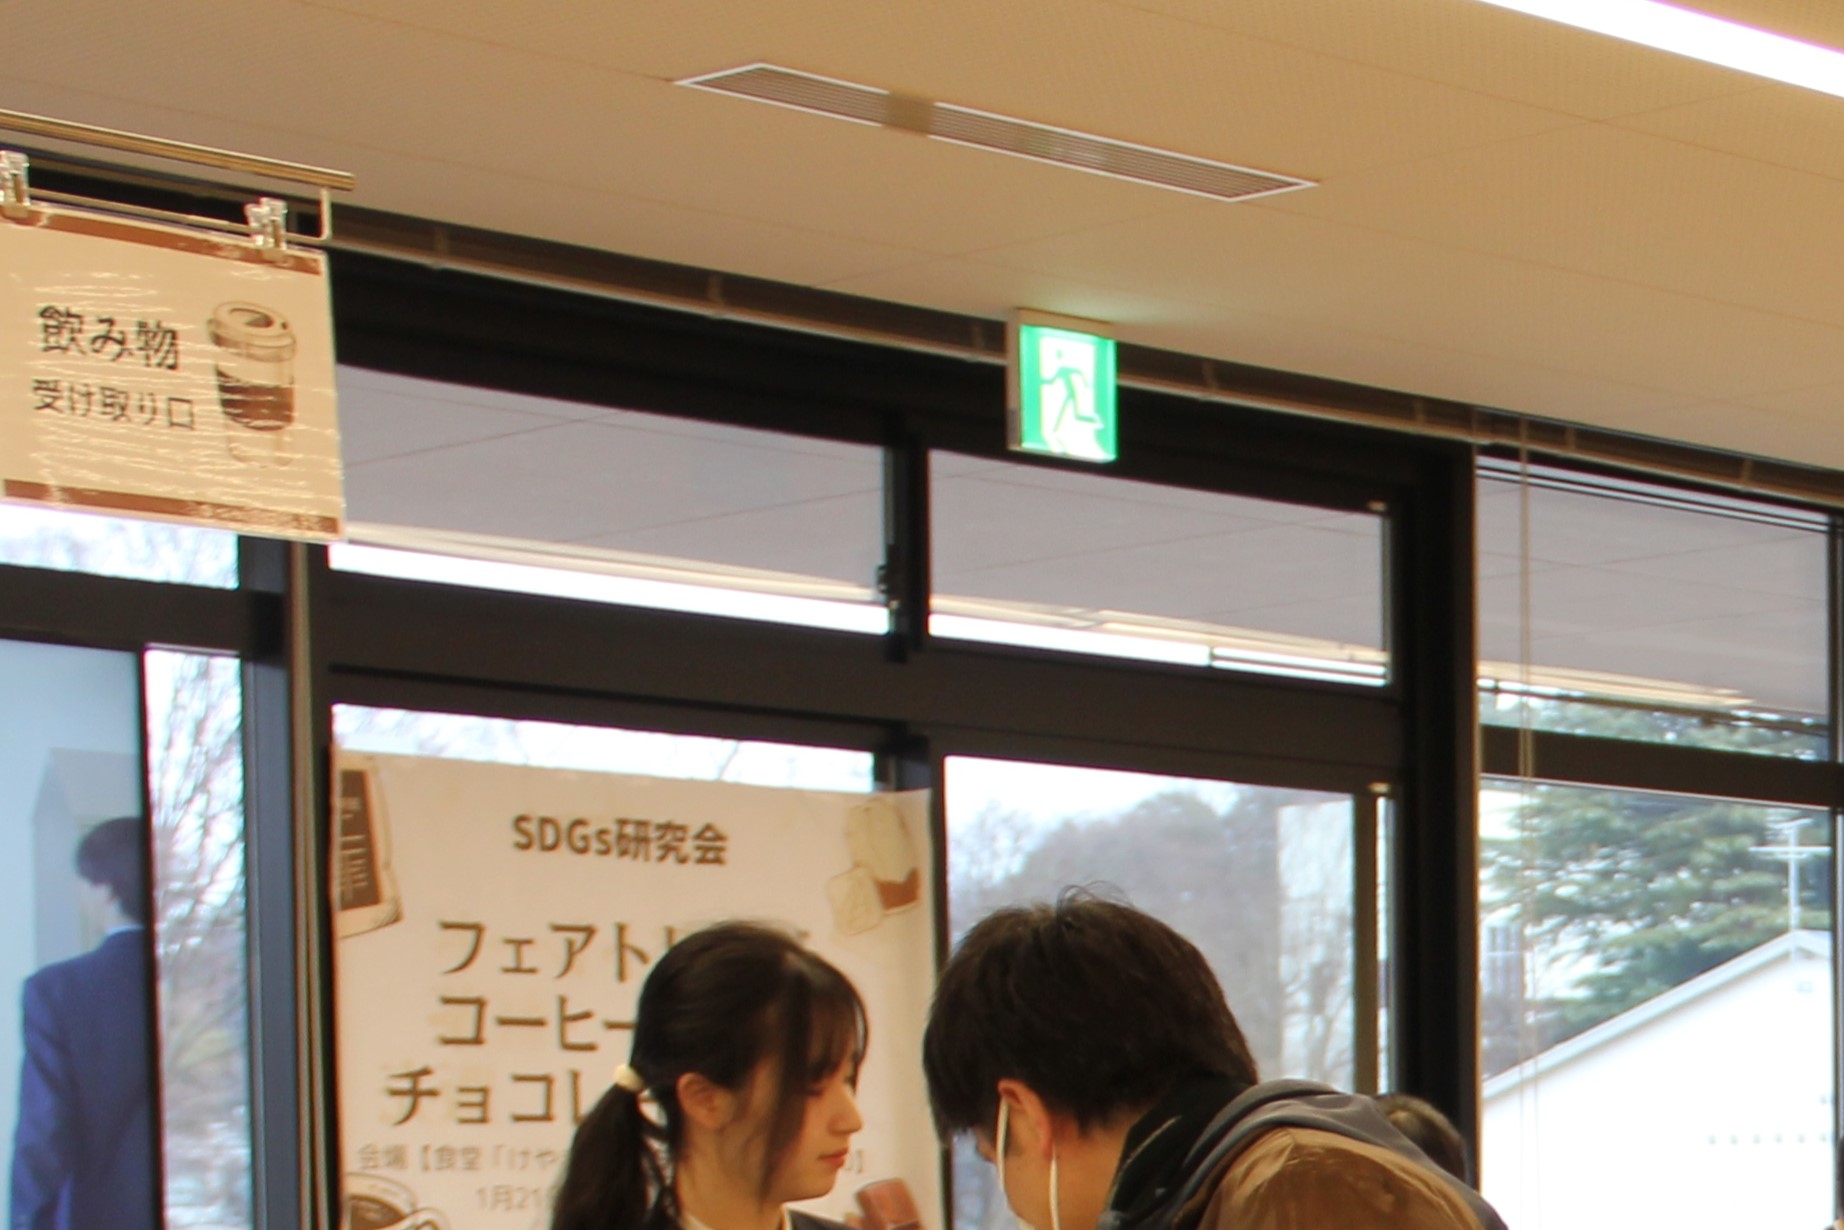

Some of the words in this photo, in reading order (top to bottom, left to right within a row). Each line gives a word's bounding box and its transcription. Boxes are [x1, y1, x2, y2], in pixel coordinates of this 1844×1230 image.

[38, 305, 179, 371] 飲み物
[32, 378, 196, 431] 受け取り口
[512, 814, 729, 866] SDGs研究会
[437, 919, 677, 984] フェアト
